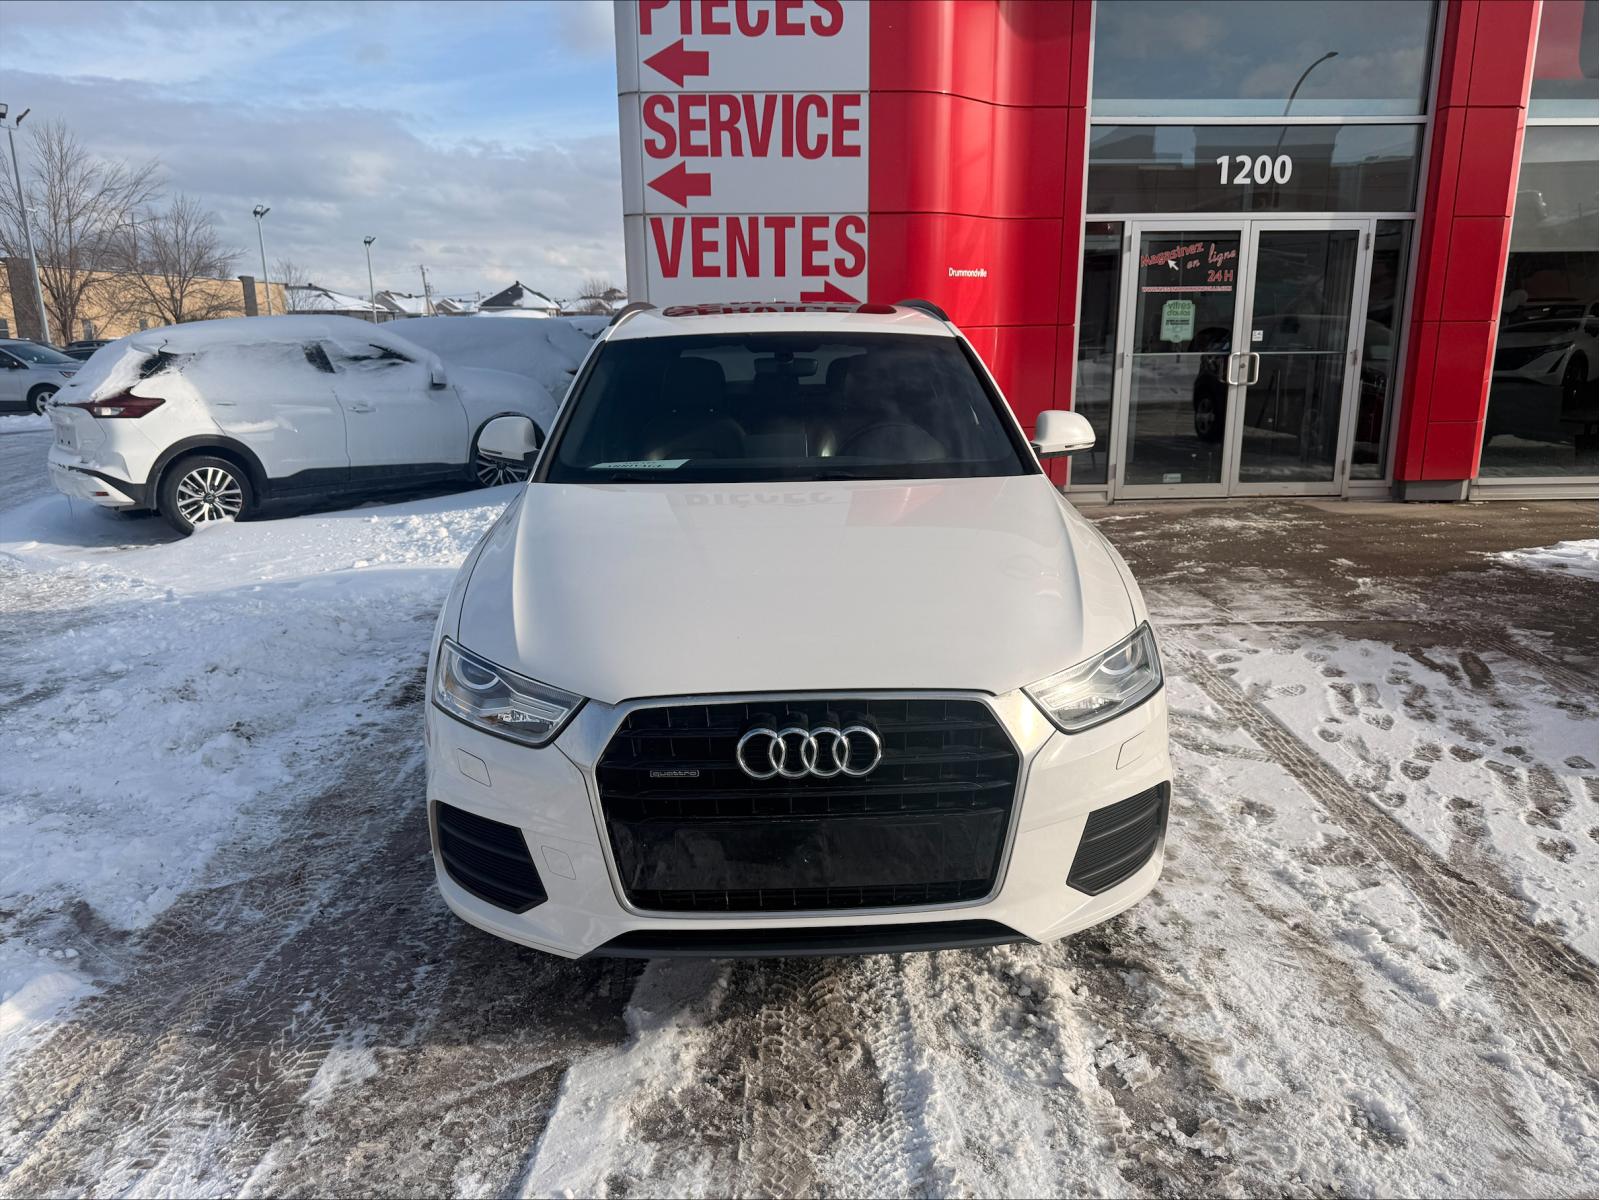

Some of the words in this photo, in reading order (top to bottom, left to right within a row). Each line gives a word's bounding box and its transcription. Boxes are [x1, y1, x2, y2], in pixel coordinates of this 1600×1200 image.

[643, 94, 862, 160] SERVICE
[1216, 155, 1293, 185] 1200
[650, 215, 866, 279] VENTES
[1141, 242, 1204, 267] Magasinez
[1207, 243, 1236, 267] ligne
[948, 267, 988, 278] Drummondville
[651, 770, 698, 778] quattro
